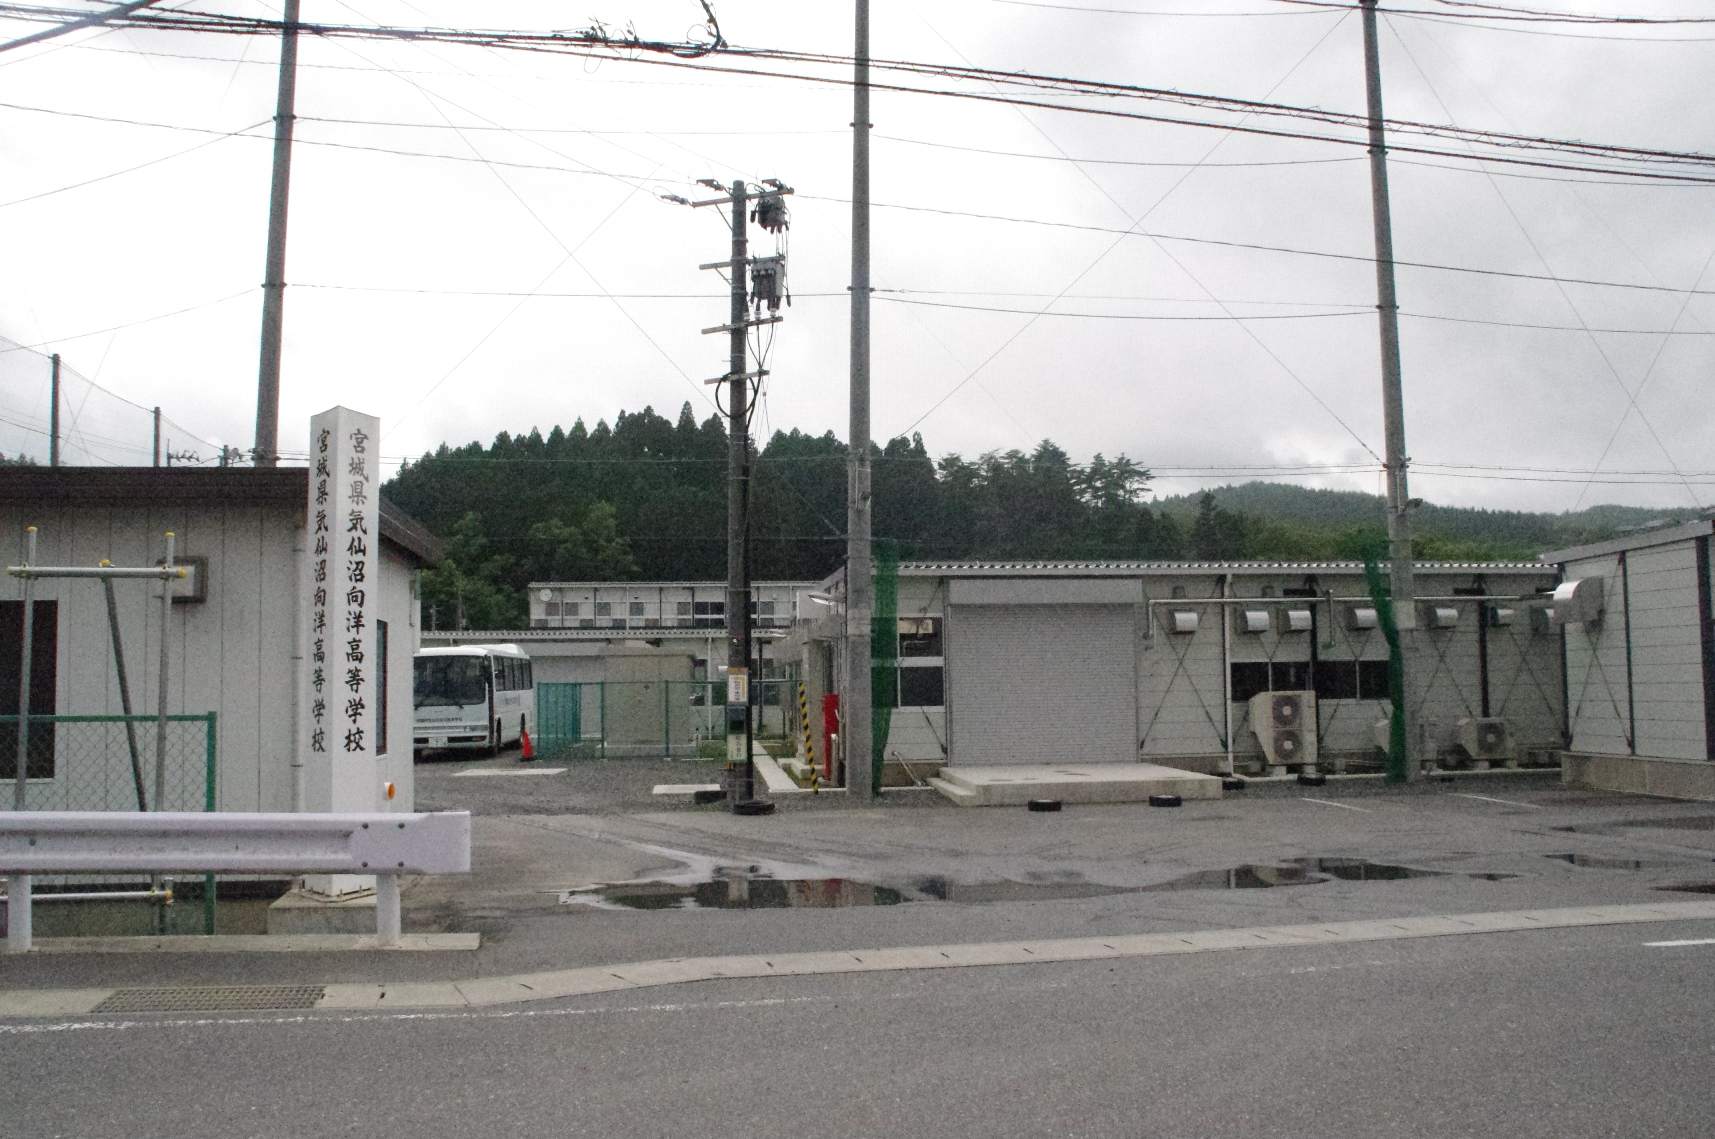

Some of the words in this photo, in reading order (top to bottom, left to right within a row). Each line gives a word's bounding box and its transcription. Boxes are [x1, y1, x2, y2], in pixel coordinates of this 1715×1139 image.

[311, 427, 330, 753] 宮城県気仙沼向洋高等学校
[343, 428, 369, 753] 宮城県気仙沼向洋高等学校
